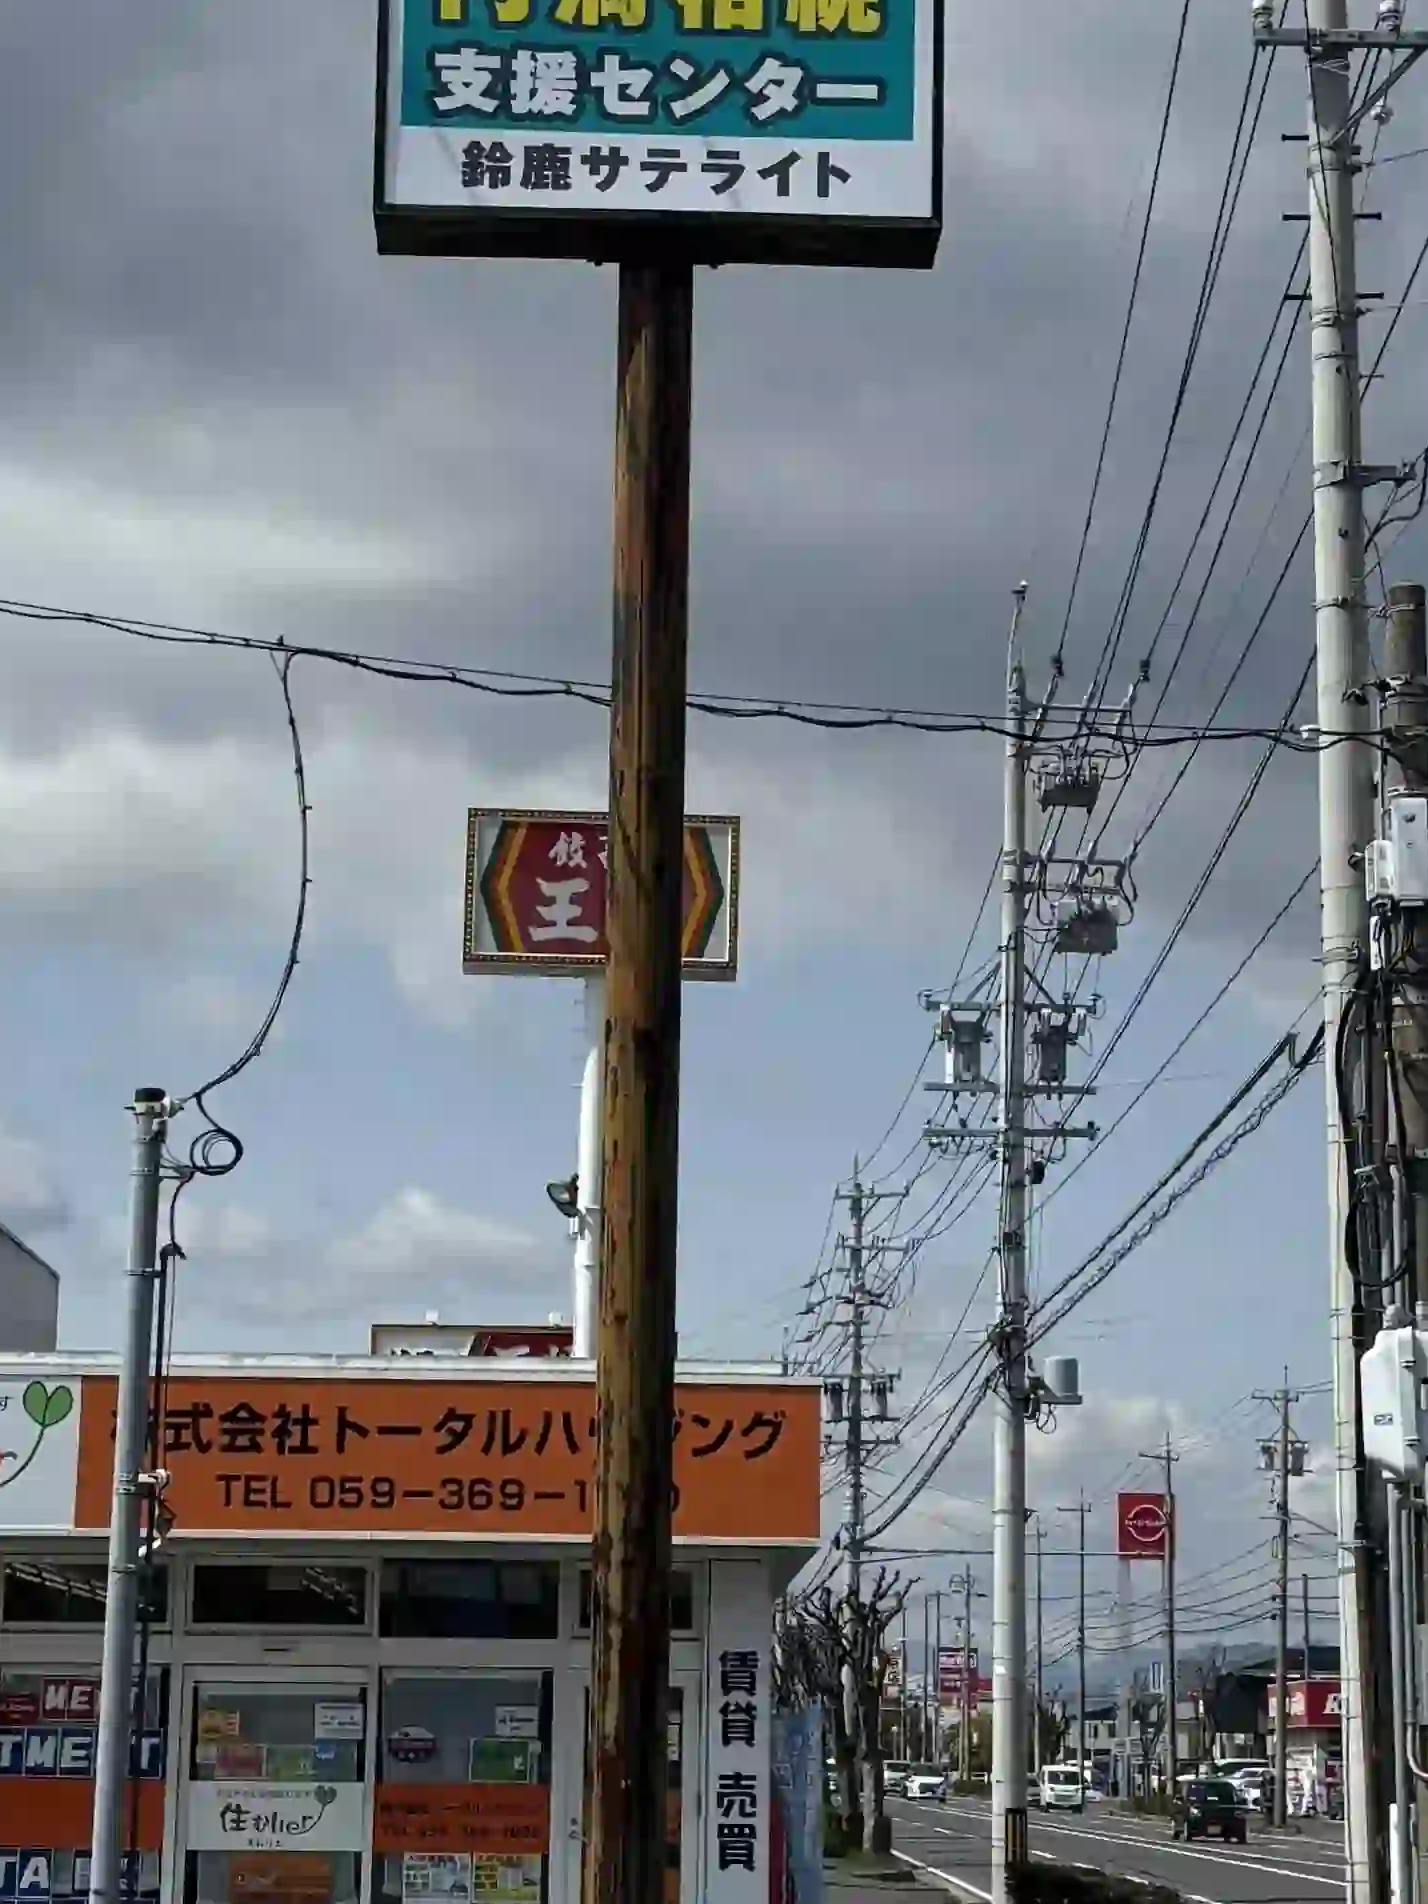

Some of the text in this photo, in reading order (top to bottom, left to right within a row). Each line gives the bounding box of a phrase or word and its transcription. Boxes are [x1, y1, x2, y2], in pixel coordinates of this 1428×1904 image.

[431, 49, 880, 121] 支援センター
[462, 142, 851, 198] 鈴鹿サテライト
[110, 1402, 788, 1461] 式会社トータルハング
[215, 1474, 293, 1509] TEL
[717, 1650, 760, 1872] 賃貸 売買
